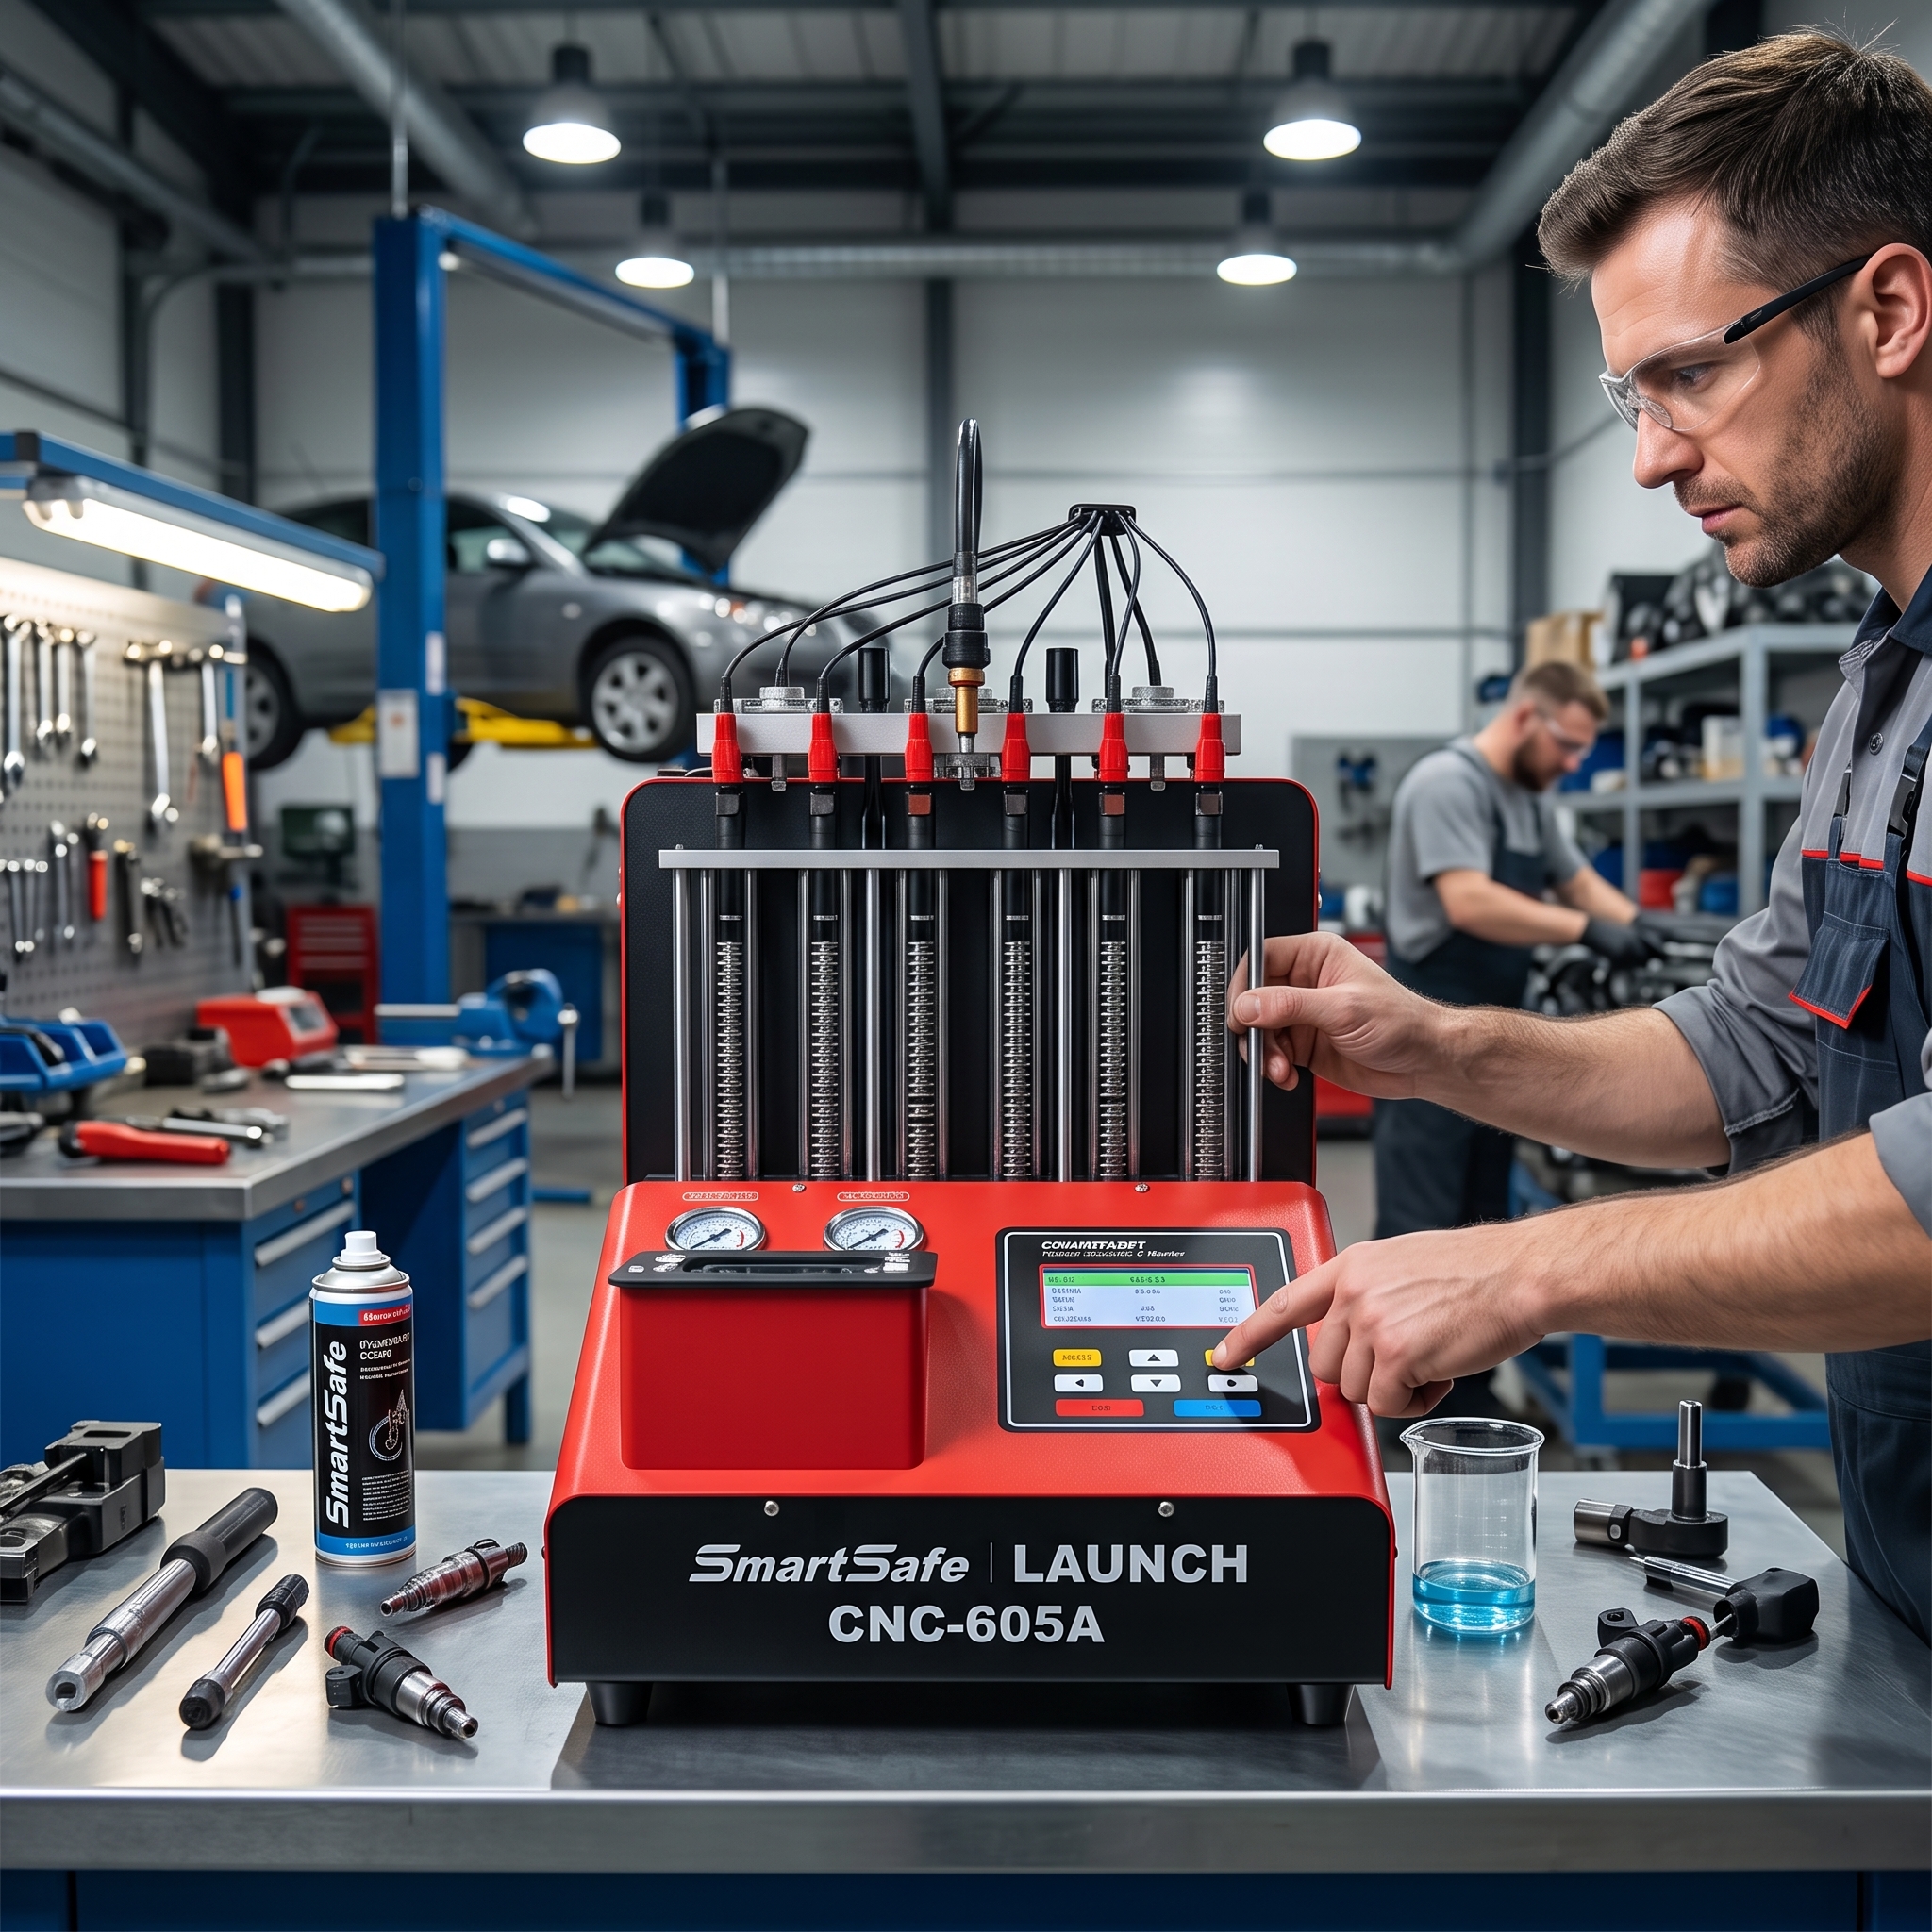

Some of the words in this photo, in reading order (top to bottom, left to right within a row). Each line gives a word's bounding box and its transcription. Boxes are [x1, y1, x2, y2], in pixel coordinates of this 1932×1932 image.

[324, 1341, 349, 1528] SmartSafe
[689, 1544, 969, 1582] SmartSafe
[1015, 1544, 1247, 1583] LAUNCH
[829, 1605, 1105, 1642] CNC-605A
